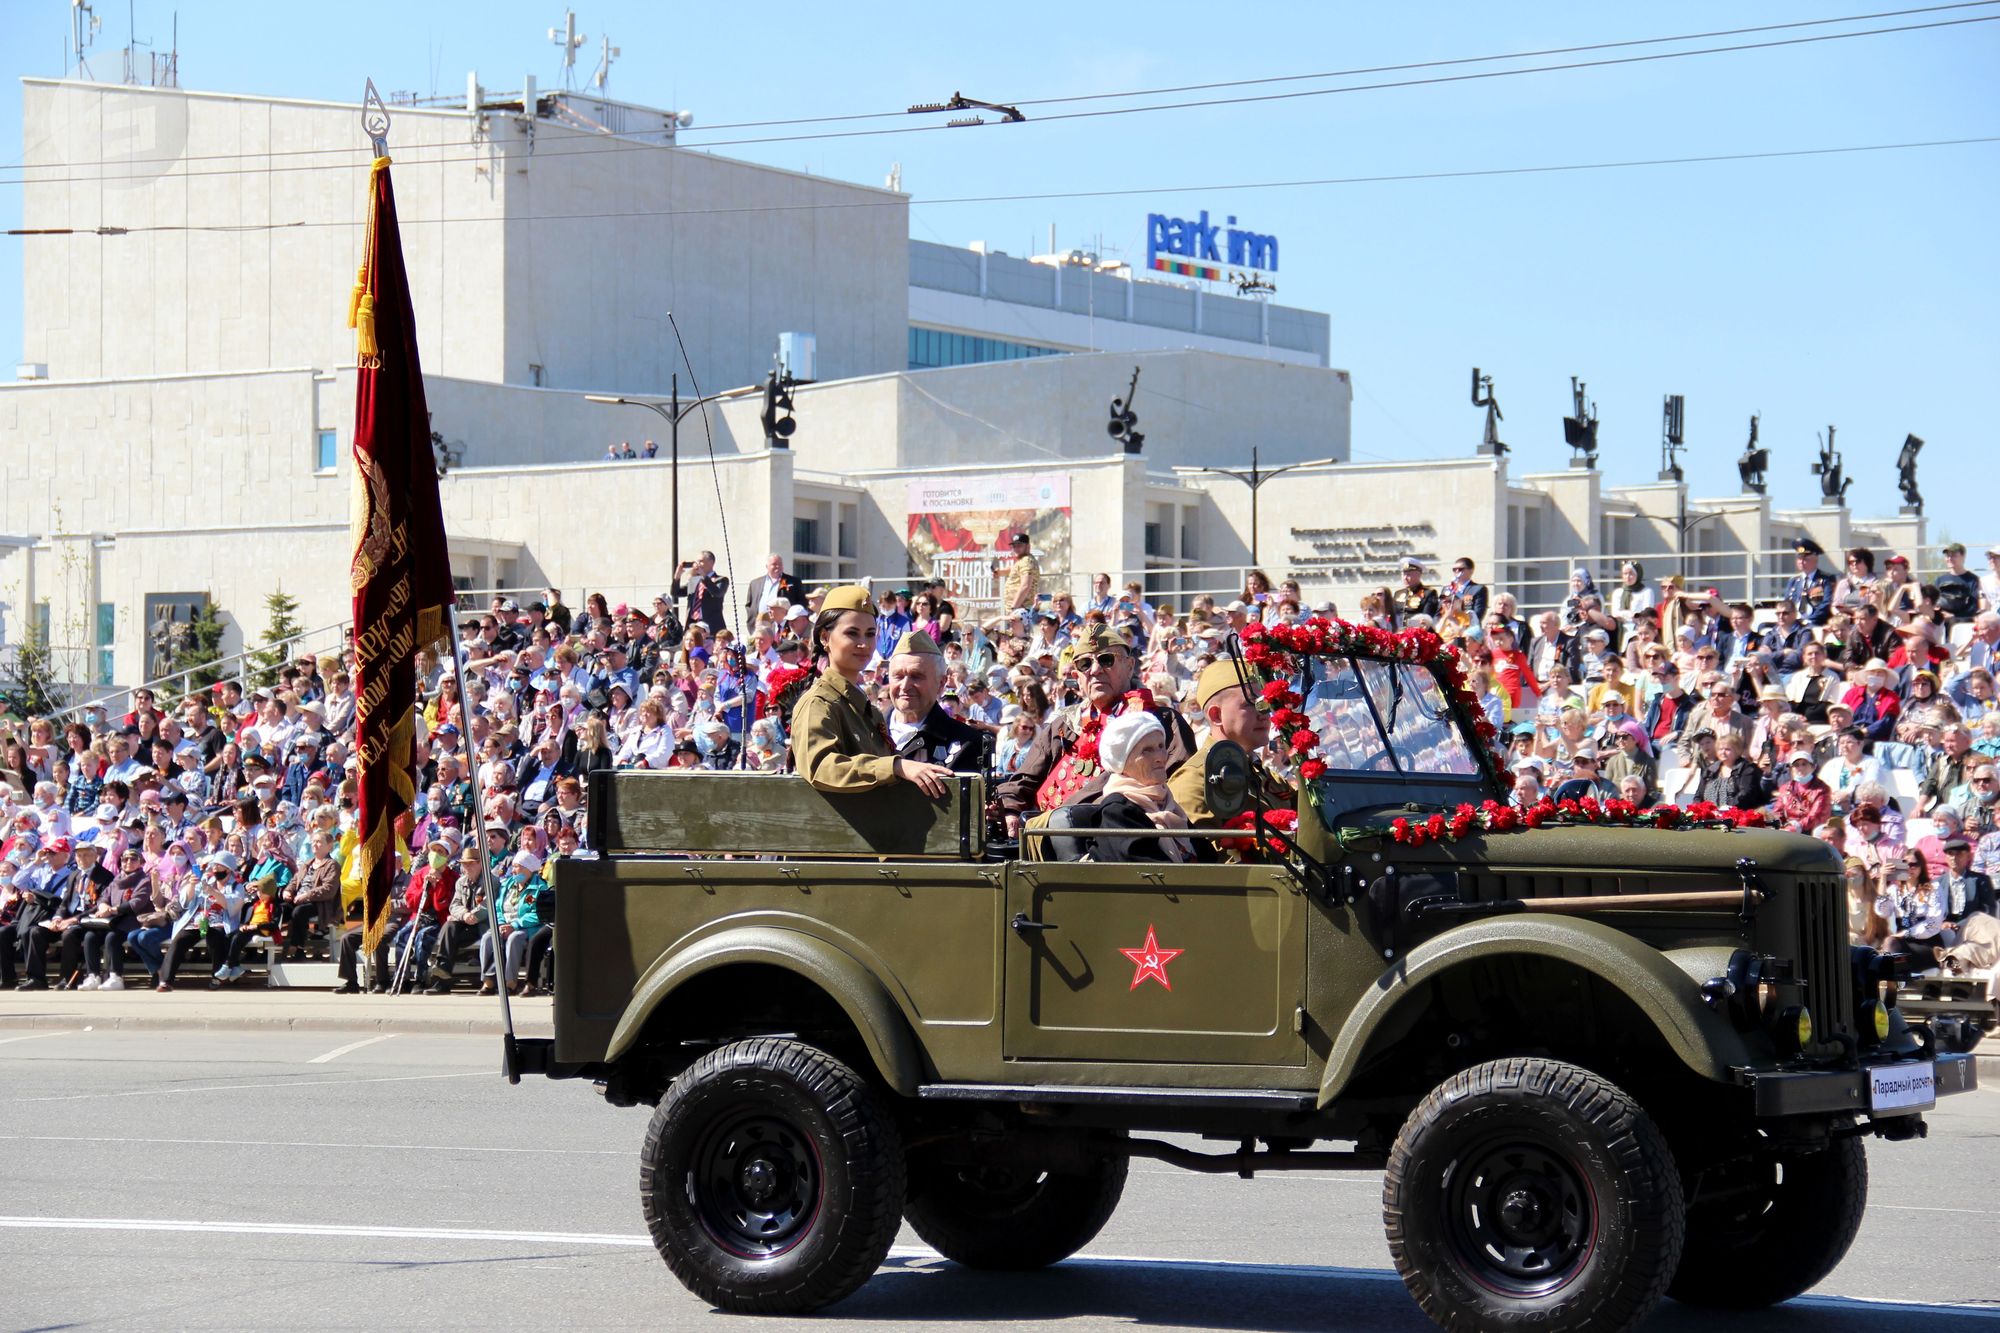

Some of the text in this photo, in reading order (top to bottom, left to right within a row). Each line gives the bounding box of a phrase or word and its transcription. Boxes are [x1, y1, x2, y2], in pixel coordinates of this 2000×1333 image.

[1147, 210, 1279, 272] park inn
[922, 488, 963, 499] ГОТОВИТСЯ
[928, 497, 975, 508] ПОСТАНОВКЕ
[1874, 1076, 1930, 1098] Парадный расчет
